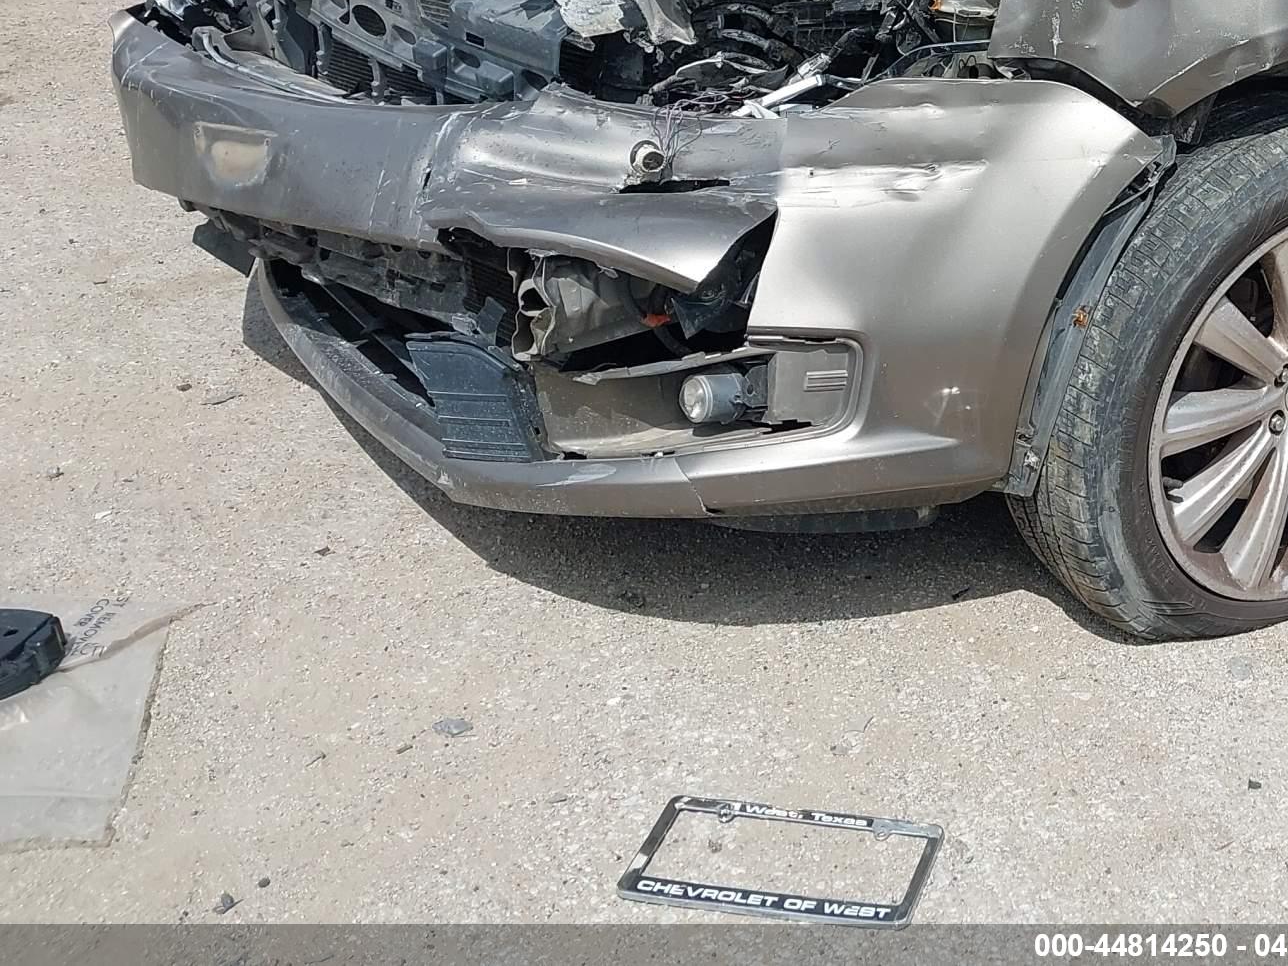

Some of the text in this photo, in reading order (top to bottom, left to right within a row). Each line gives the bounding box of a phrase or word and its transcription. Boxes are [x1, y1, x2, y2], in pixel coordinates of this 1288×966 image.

[73, 598, 110, 627] COVER
[810, 811, 868, 827] Texas
[636, 879, 779, 907] CHEVROLET
[783, 898, 817, 911] OF
